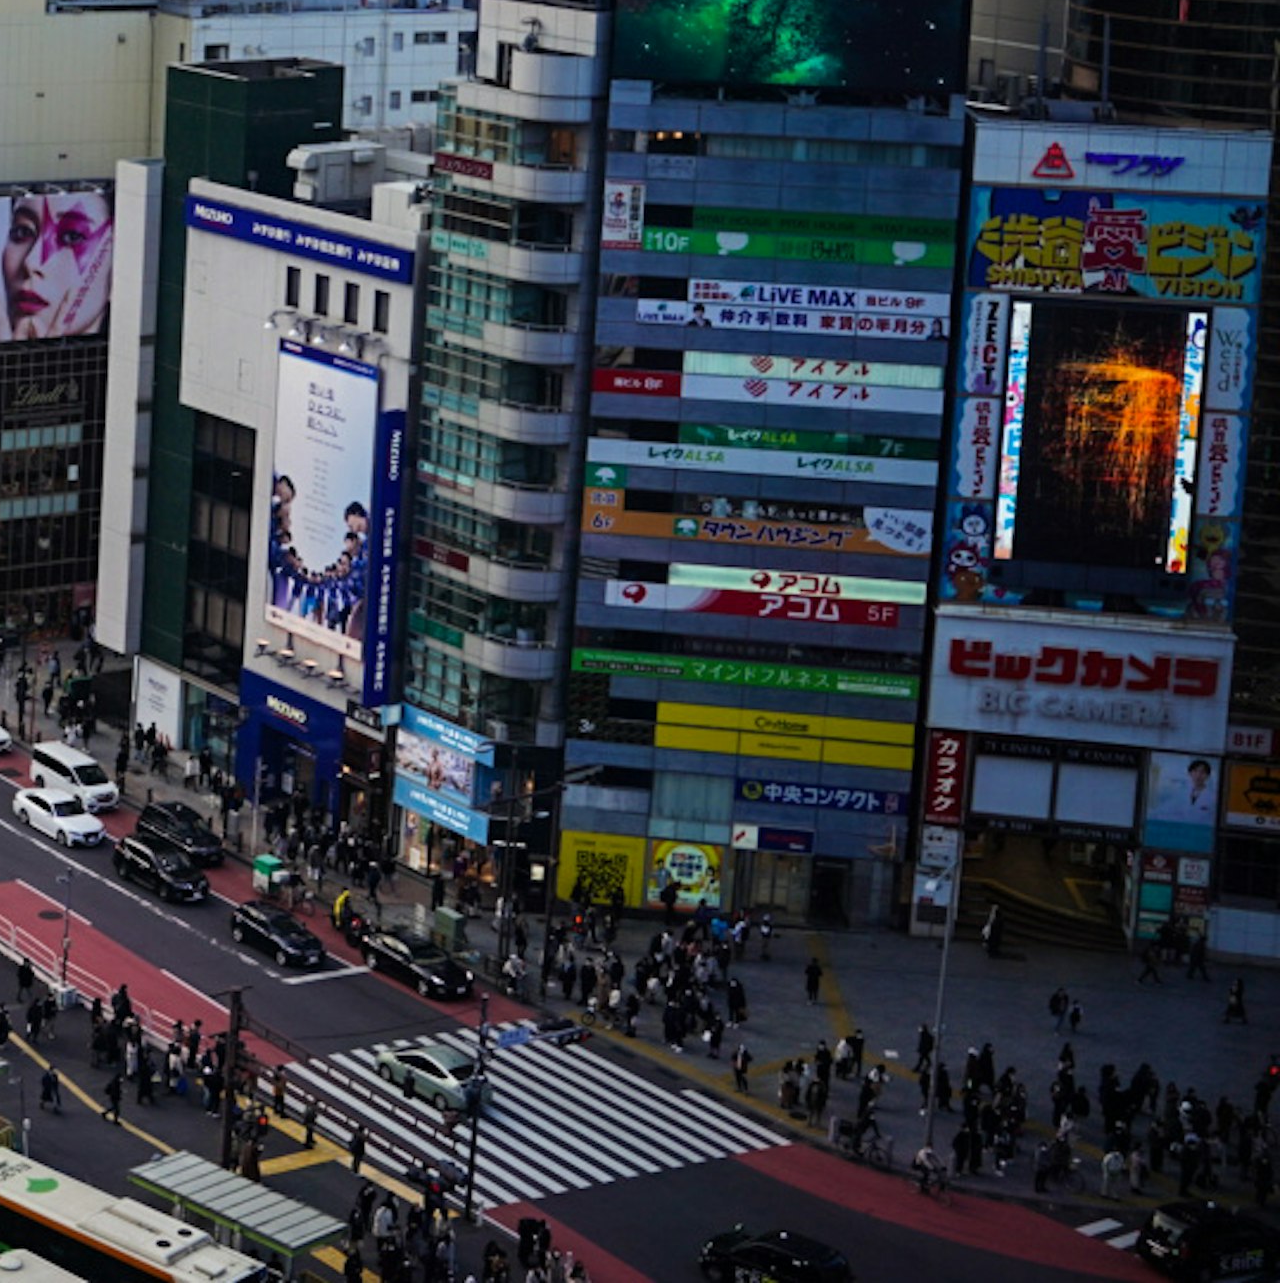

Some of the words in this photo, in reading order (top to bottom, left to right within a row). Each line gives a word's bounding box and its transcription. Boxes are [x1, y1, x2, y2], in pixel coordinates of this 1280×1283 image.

[194, 203, 234, 225] MIZUHO
[653, 231, 690, 252] 10F
[986, 267, 1083, 291] SHIBUYA
[1102, 271, 1128, 292] AI
[1156, 278, 1243, 299] VISION
[808, 289, 856, 308] MAX
[790, 355, 870, 377] アイフル
[14, 381, 67, 406] Lindt
[787, 381, 871, 401] アイフル
[727, 426, 798, 446] レイクALSA
[389, 429, 402, 481] MIZUHO
[648, 446, 726, 463] レイクALSA
[797, 456, 875, 474] レイクALSA
[593, 514, 615, 529] 6F
[777, 574, 841, 595] アコム
[757, 593, 841, 622] アコム
[867, 606, 895, 621] 5F
[690, 661, 832, 689] マインドフルネス
[950, 638, 1219, 697] ビックカメラ
[266, 694, 308, 724] MIZUHO
[979, 690, 1030, 717] BIC
[1040, 697, 1179, 730] CAMERA
[931, 735, 961, 813] カラオケ
[763, 781, 882, 811] 中央コンタクト
